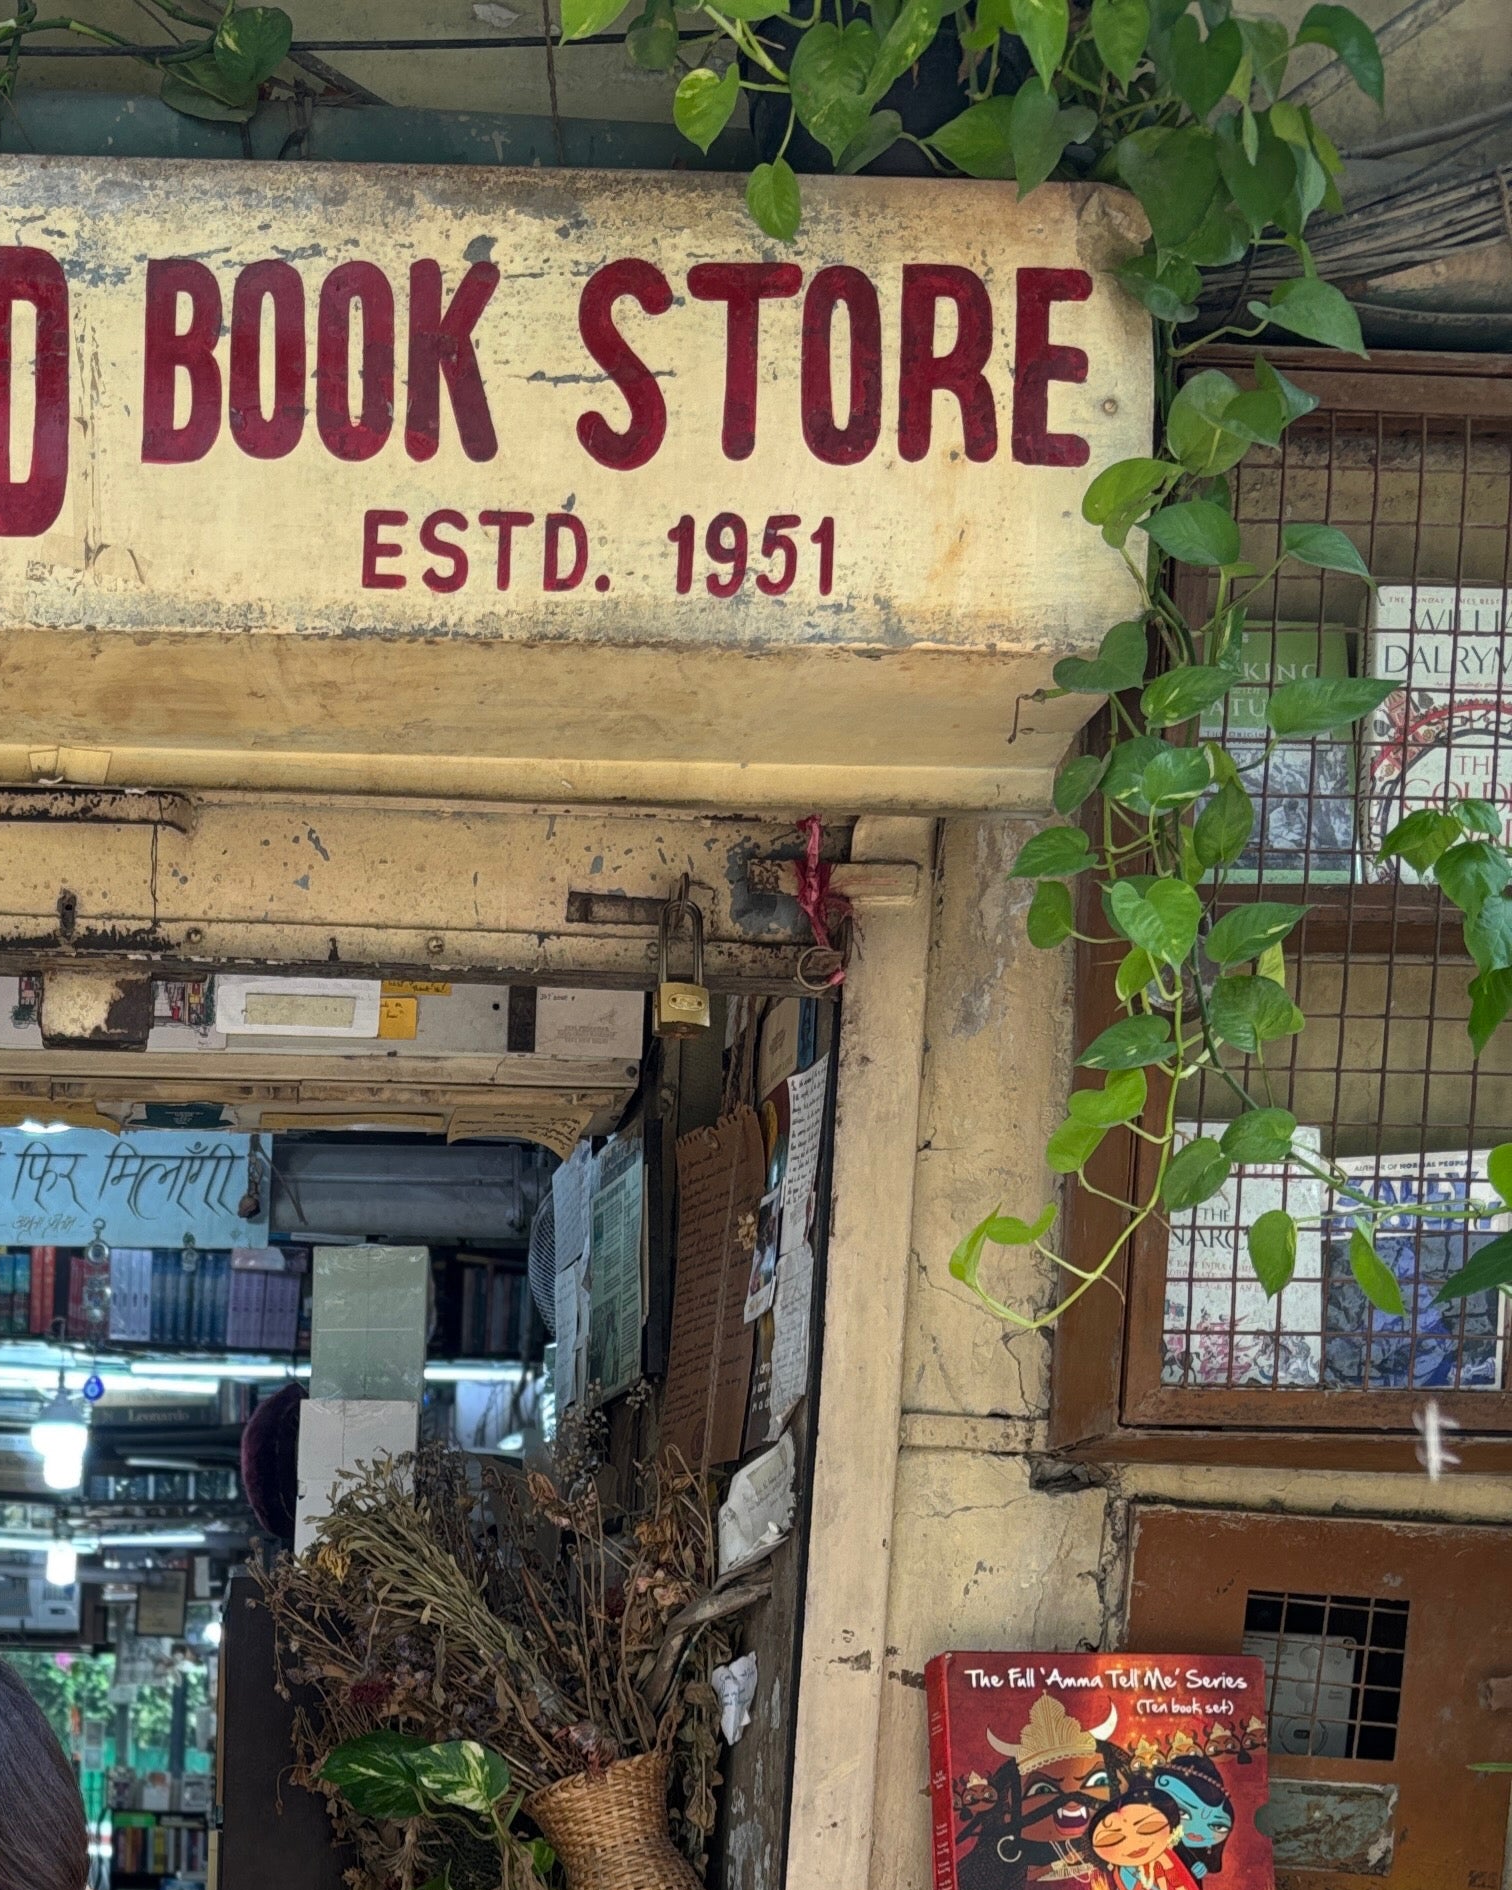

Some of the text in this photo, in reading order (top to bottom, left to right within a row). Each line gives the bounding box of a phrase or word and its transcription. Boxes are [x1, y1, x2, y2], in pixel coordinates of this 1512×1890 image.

[140, 256, 501, 464] BOOK
[575, 257, 1094, 471] STORE
[361, 508, 836, 598] ESTD. 1951
[13, 1141, 91, 1215] फिर
[1354, 1163, 1386, 1172] AUTHR
[964, 1668, 1004, 1690] The
[1008, 1667, 1036, 1689] Full
[1105, 1667, 1139, 1689] Tell
[1185, 1667, 1249, 1690] Series
[1136, 1697, 1235, 1716] (Ten book set)
